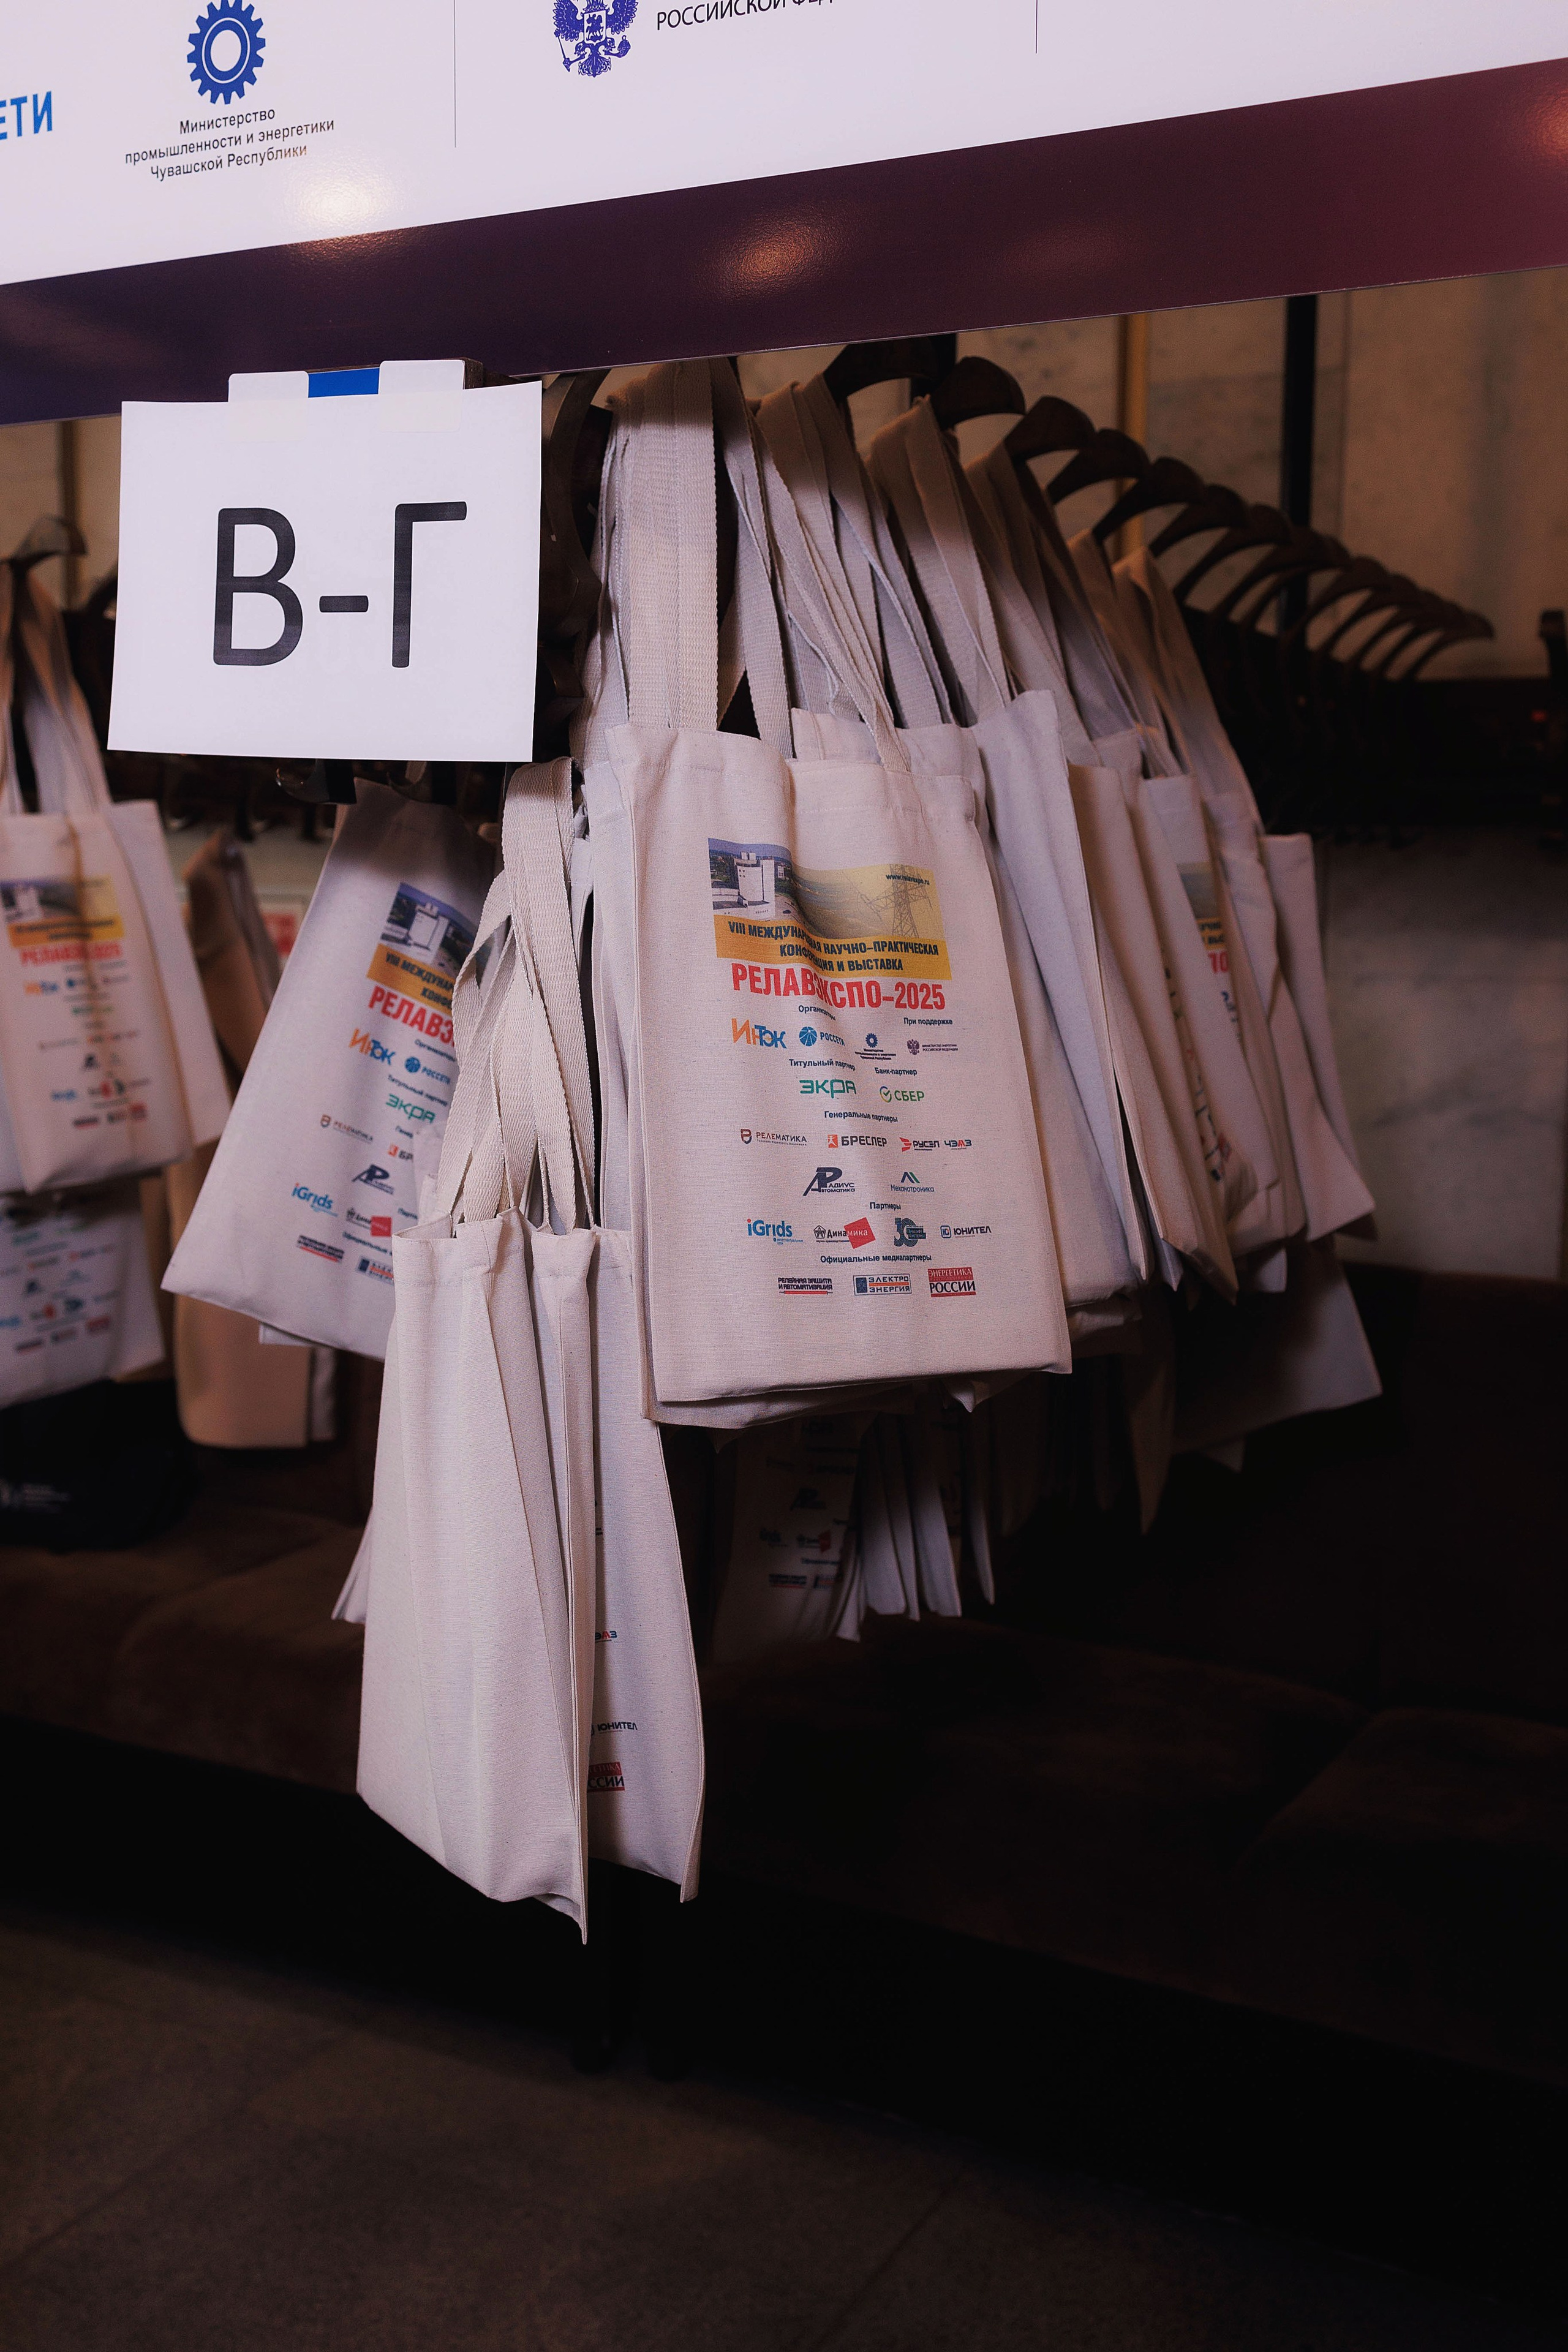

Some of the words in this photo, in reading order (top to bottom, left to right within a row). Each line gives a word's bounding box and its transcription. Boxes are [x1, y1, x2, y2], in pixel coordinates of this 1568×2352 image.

[180, 109, 275, 134] Министерство
[126, 135, 242, 165] промышленности
[246, 133, 254, 144] и
[258, 120, 334, 141] энергетики
[151, 156, 223, 182] Чувашской
[228, 145, 307, 167] Республики
[213, 501, 467, 668] В-Г
[728, 921, 745, 935] VIII
[837, 960, 845, 971] И
[848, 959, 903, 971] ВЫСТАВКА
[369, 986, 454, 1047] РЕЛАВЭ
[820, 1032, 845, 1046] РОССЕТИ
[789, 1059, 834, 1068] Титульный
[875, 1067, 918, 1076] Банк-партнер
[894, 1090, 924, 1101] СБЕР
[824, 1110, 870, 1120] Генеральные
[756, 1132, 807, 1142] РЕЛЕМАТИКА
[842, 1136, 888, 1147] БРЕСЛЕР
[292, 1183, 333, 1209] iGrids
[870, 1202, 901, 1211] Партнеры
[747, 1218, 793, 1237] iGrids
[954, 1226, 992, 1235] ЮНИТЕЛ
[827, 1229, 868, 1238] Динамика
[929, 1268, 972, 1277] ЭНЕРГЕТИКА
[929, 1281, 976, 1293] РОССИИ
[597, 1722, 638, 1731] ЮНИТЕЛ
